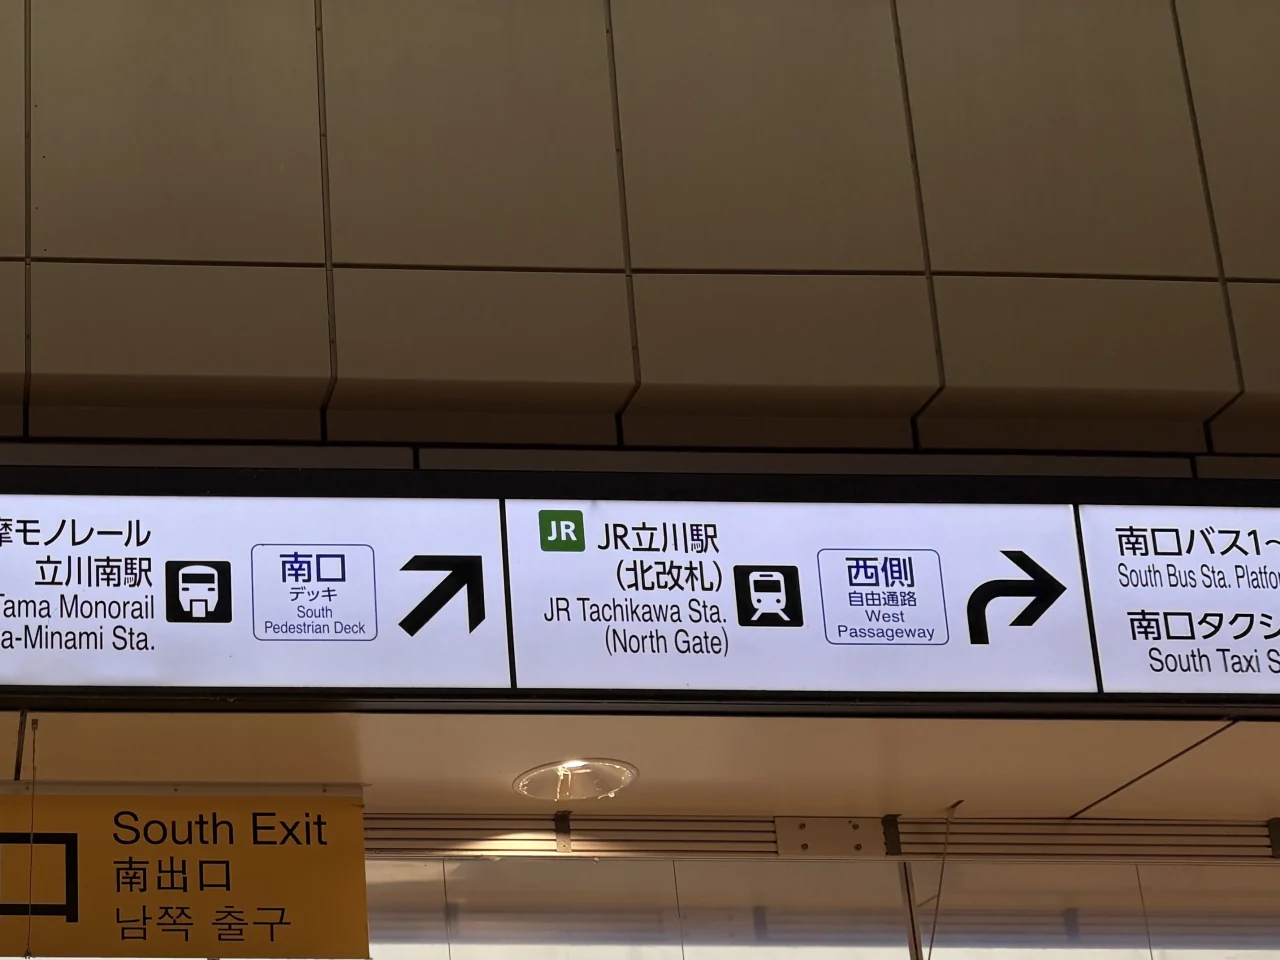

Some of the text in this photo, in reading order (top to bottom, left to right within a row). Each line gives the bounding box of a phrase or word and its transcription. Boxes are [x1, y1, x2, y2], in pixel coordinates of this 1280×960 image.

[547, 521, 577, 541] JR
[597, 522, 720, 553] JR立川駅
[34, 555, 153, 588] 立川南駅
[279, 551, 346, 583] 南口
[616, 559, 723, 592] (北改札)
[845, 556, 915, 588] 西側
[1117, 562, 1280, 590] South Bus Sta. Platfo
[60, 594, 154, 619] Monorail
[289, 586, 338, 602] デッキ
[848, 590, 917, 607] 自由通路
[297, 605, 333, 618] South
[544, 597, 727, 623] JR Tachikawa Sta.
[865, 609, 905, 622] West
[112, 625, 155, 650] Sta.
[264, 621, 366, 634] Pedestrian Deck
[837, 624, 935, 641] Passageway
[605, 625, 729, 657] (North Gate)
[1148, 647, 1212, 673] South
[1216, 648, 1261, 673] Taxi
[112, 811, 328, 846] South Exit
[113, 856, 233, 893] 南出口
[115, 905, 292, 943] 남쪽 출구
